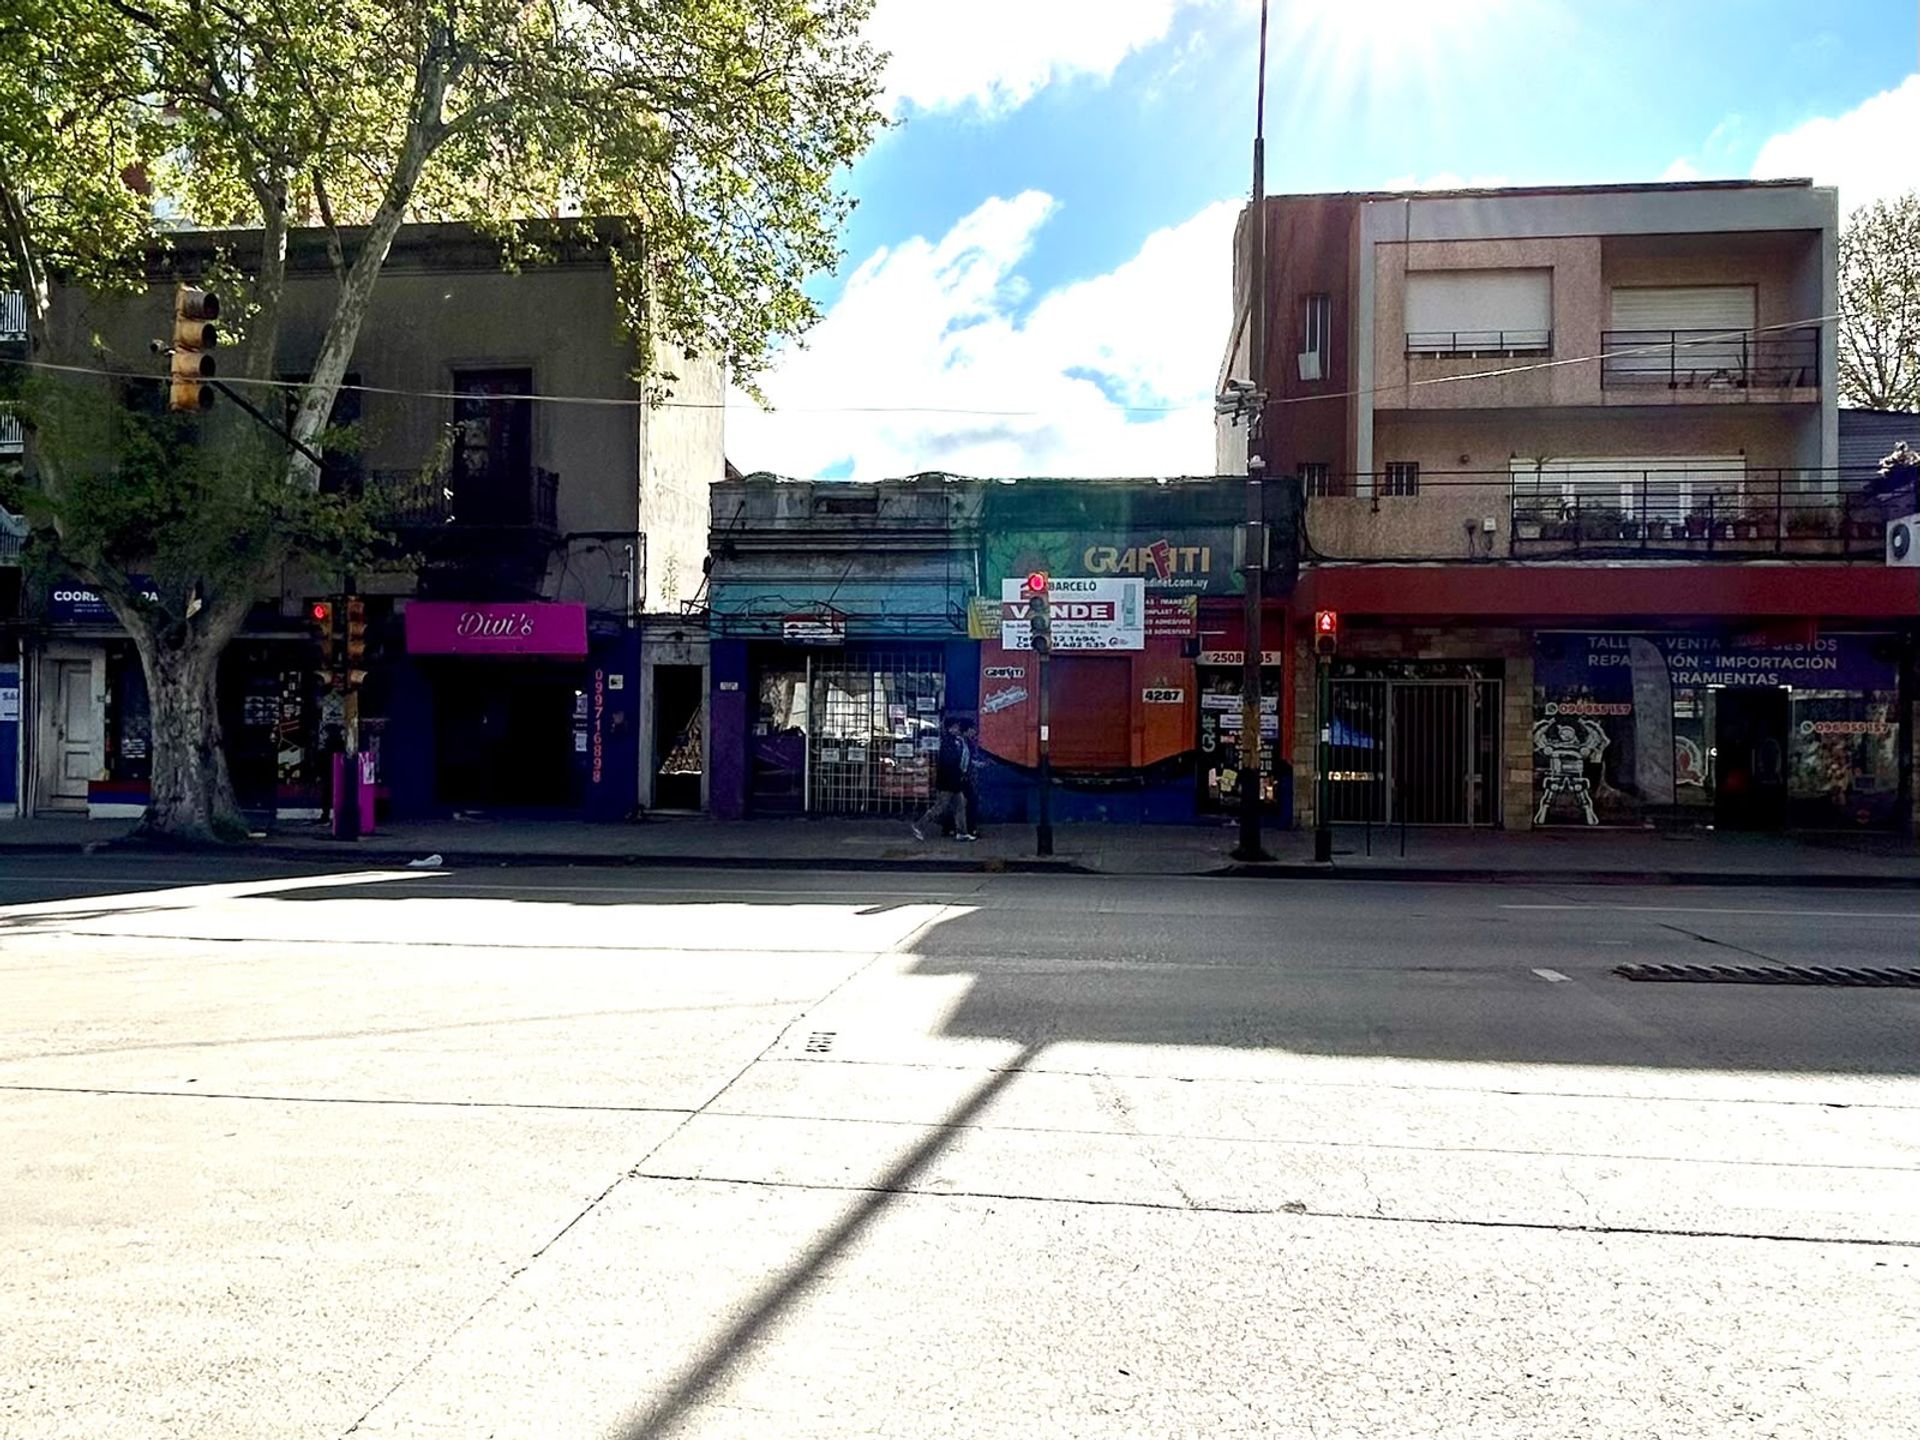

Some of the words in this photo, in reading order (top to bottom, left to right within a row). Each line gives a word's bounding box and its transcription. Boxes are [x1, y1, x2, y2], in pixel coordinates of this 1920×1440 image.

[1084, 539, 1210, 580] GRAFFITI
[1009, 604, 1108, 620] VNDE
[457, 612, 534, 637] Divi's
[1666, 636, 1721, 651] VENTA
[1716, 654, 1837, 670] IMPORTACIÓN
